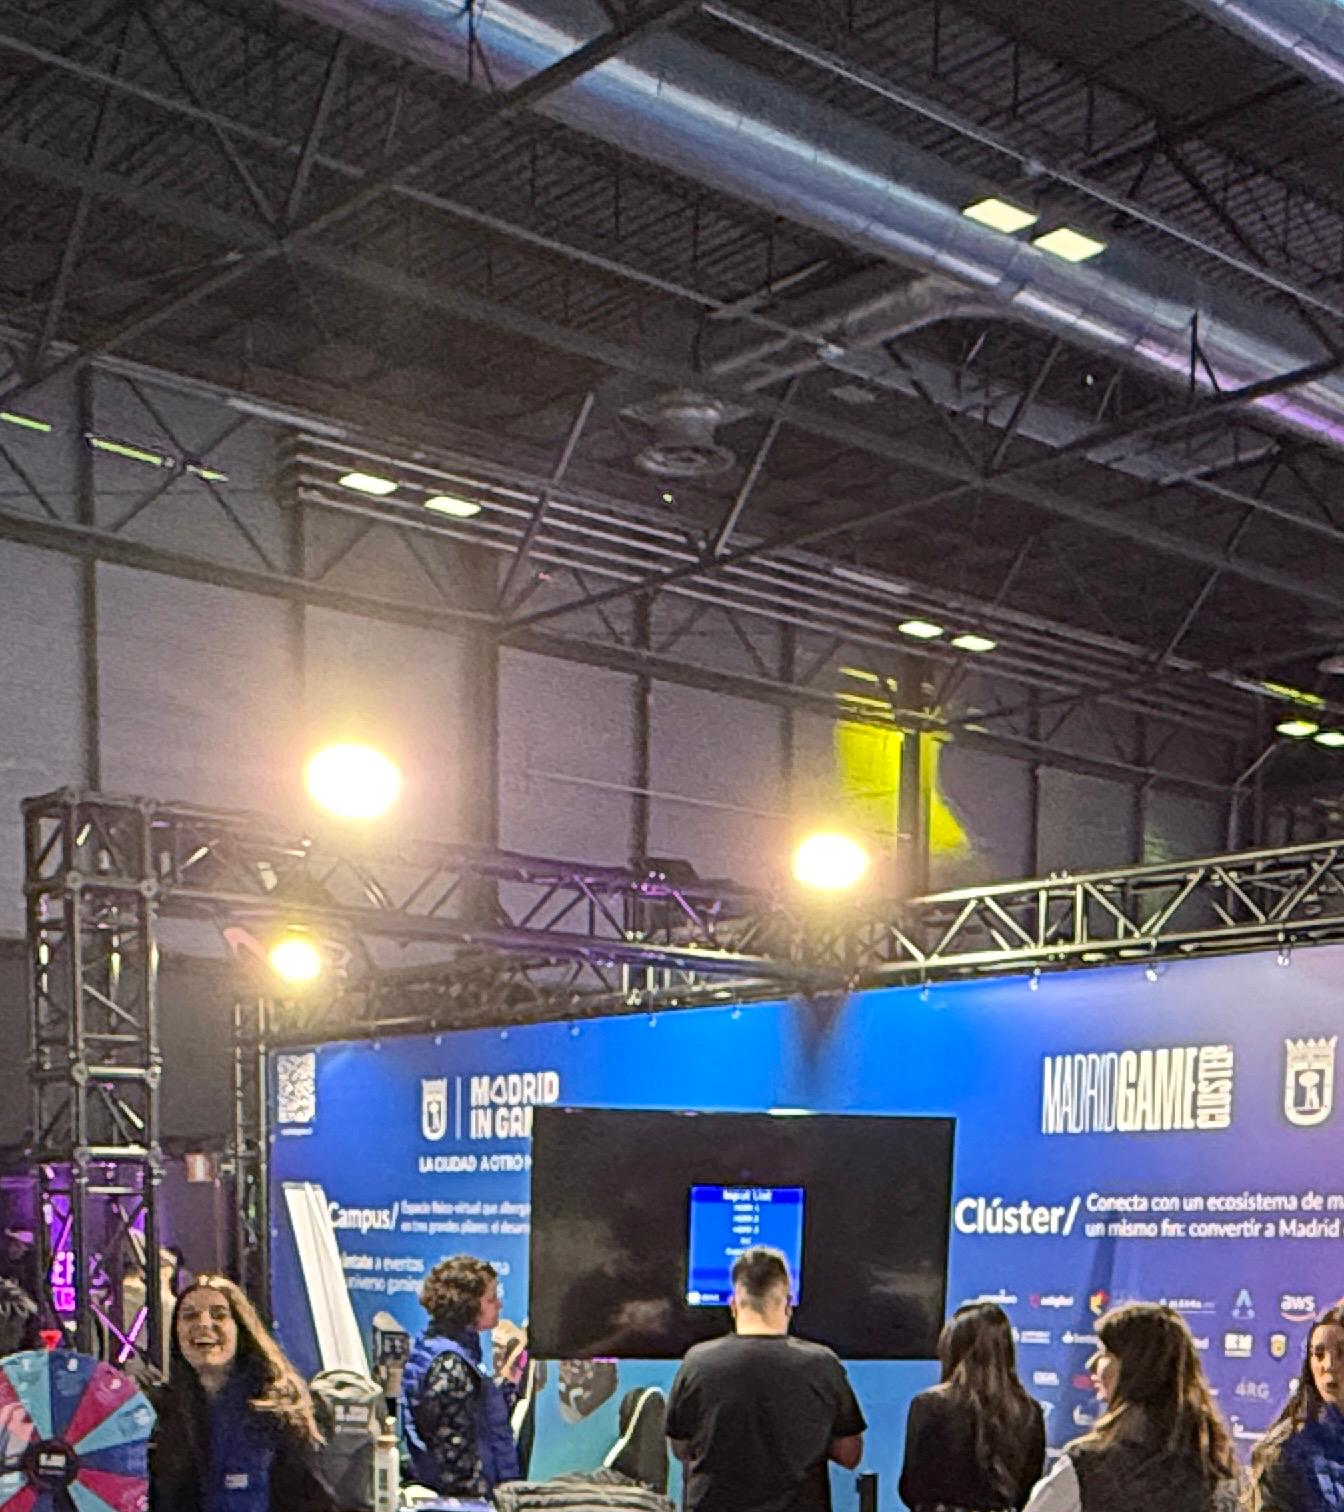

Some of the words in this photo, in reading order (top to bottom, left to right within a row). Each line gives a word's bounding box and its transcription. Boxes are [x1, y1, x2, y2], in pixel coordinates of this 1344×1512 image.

[470, 1107, 492, 1140] IN
[955, 1195, 1080, 1236] Clúster/
[1086, 1192, 1147, 1212] Conecta
[1151, 1197, 1180, 1212] con
[1183, 1197, 1202, 1212] un
[1207, 1191, 1297, 1212] ecosistema
[1301, 1190, 1324, 1211] de
[1085, 1223, 1105, 1238] un
[1108, 1218, 1157, 1238] mismo
[1189, 1218, 1262, 1238] convertir
[1264, 1224, 1276, 1238] a
[1279, 1217, 1339, 1238] Madrid
[1280, 1294, 1317, 1312] aws
